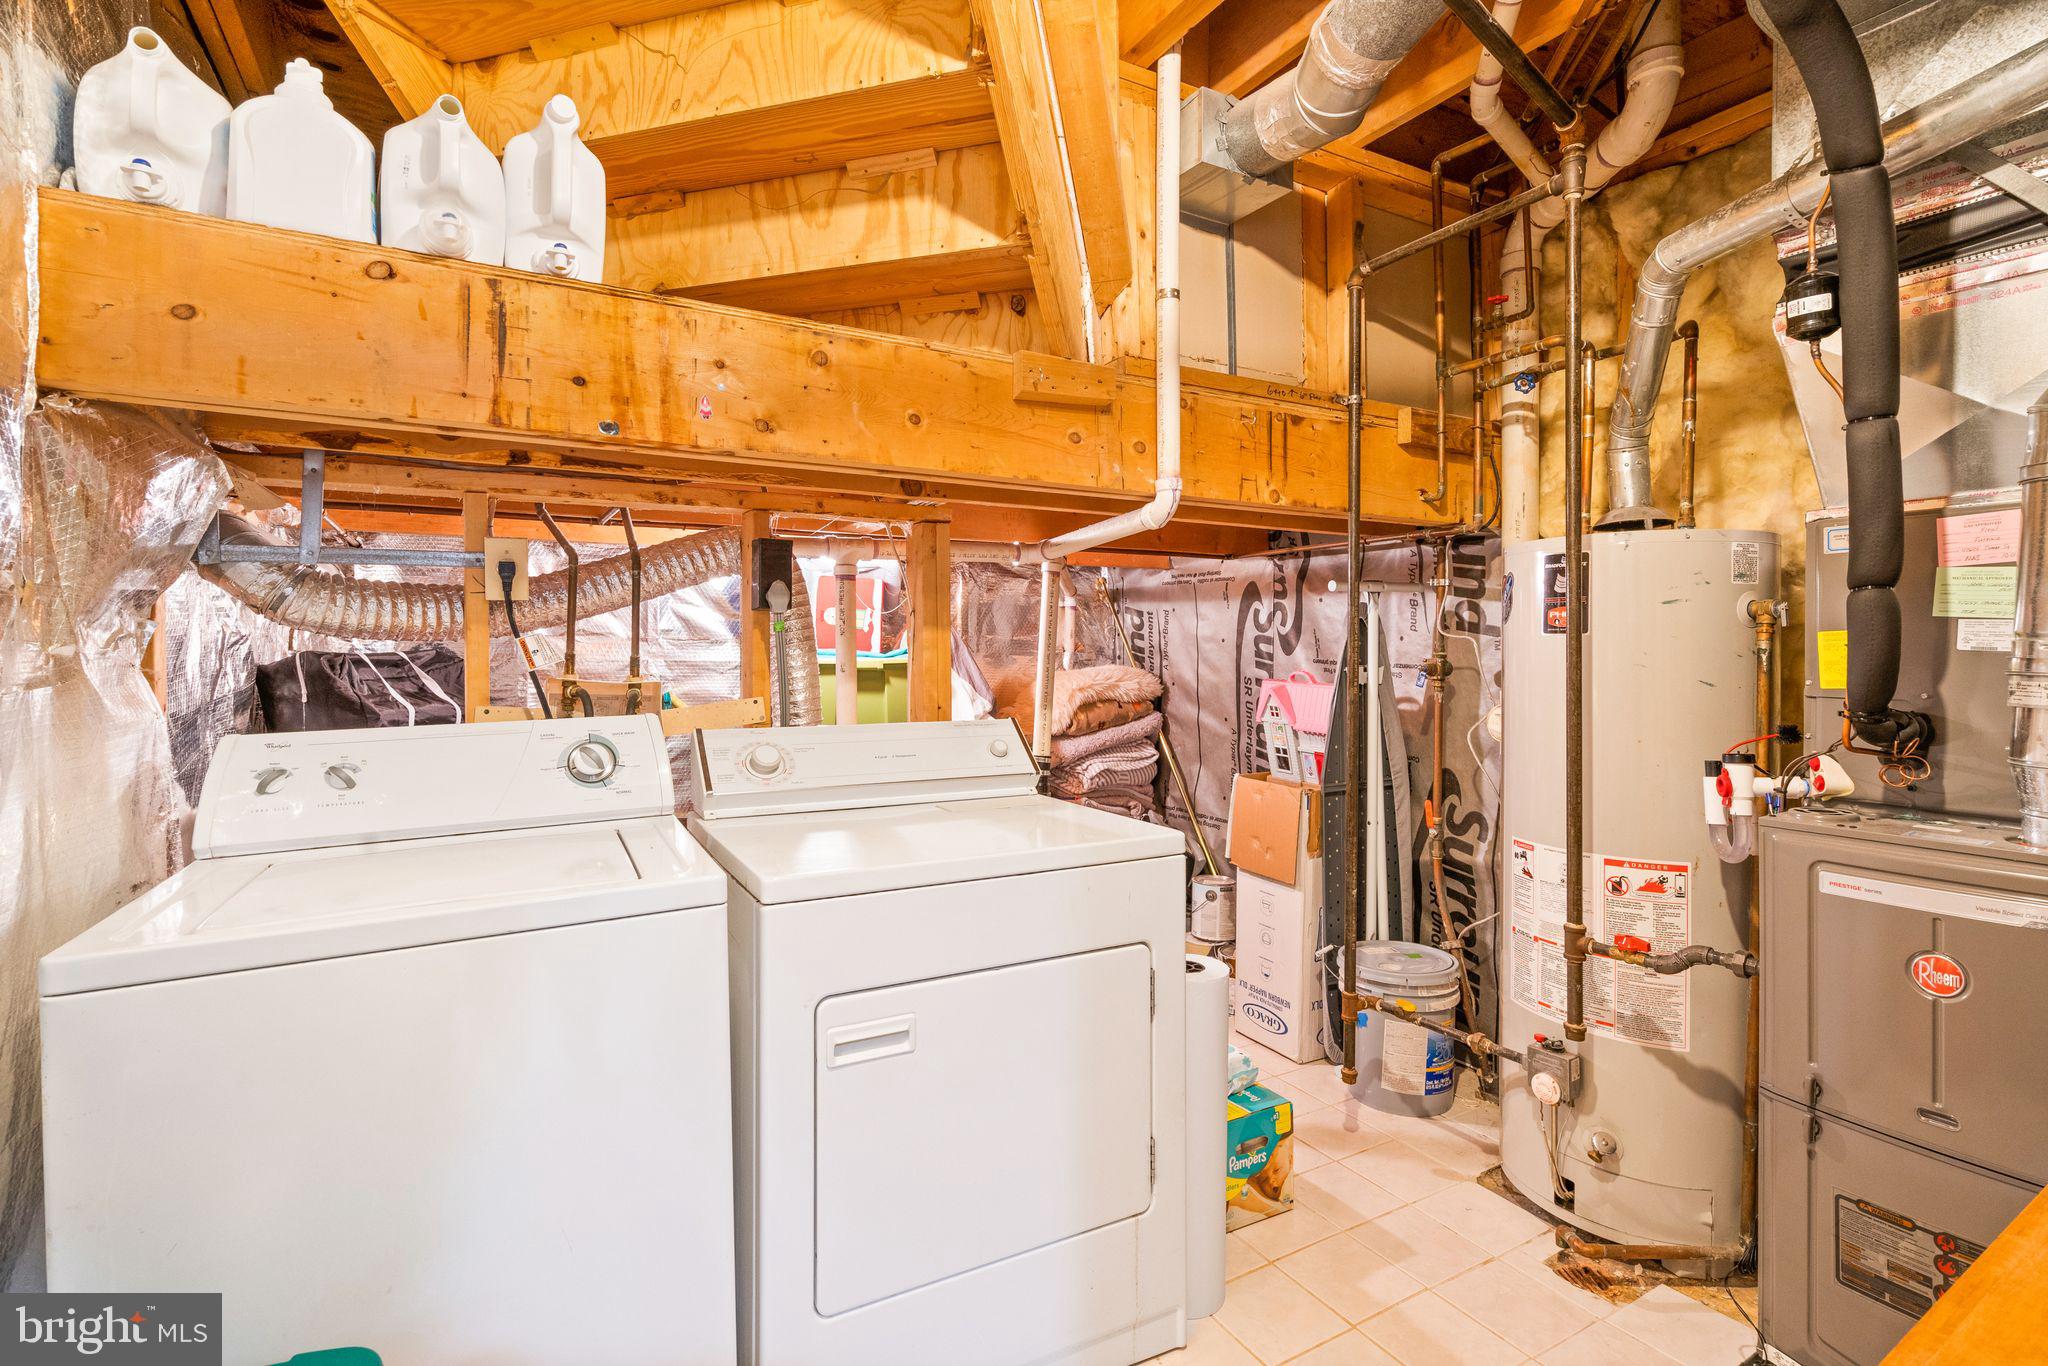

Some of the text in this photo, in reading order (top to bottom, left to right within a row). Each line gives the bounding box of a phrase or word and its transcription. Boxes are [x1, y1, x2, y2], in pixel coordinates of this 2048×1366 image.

[1990, 287, 2021, 300] 324A
[1409, 598, 1419, 632] Brand
[1243, 676, 1253, 697] SR
[1829, 881, 1882, 896] PRESTIGE series
[1975, 905, 2001, 916] Variable
[2002, 908, 2024, 919] Speed
[1918, 957, 1961, 991] Rheem
[1246, 1006, 1281, 1032] GRACO
[1229, 1151, 1267, 1173] Pampers
[1871, 1207, 1905, 1225] WARNING
